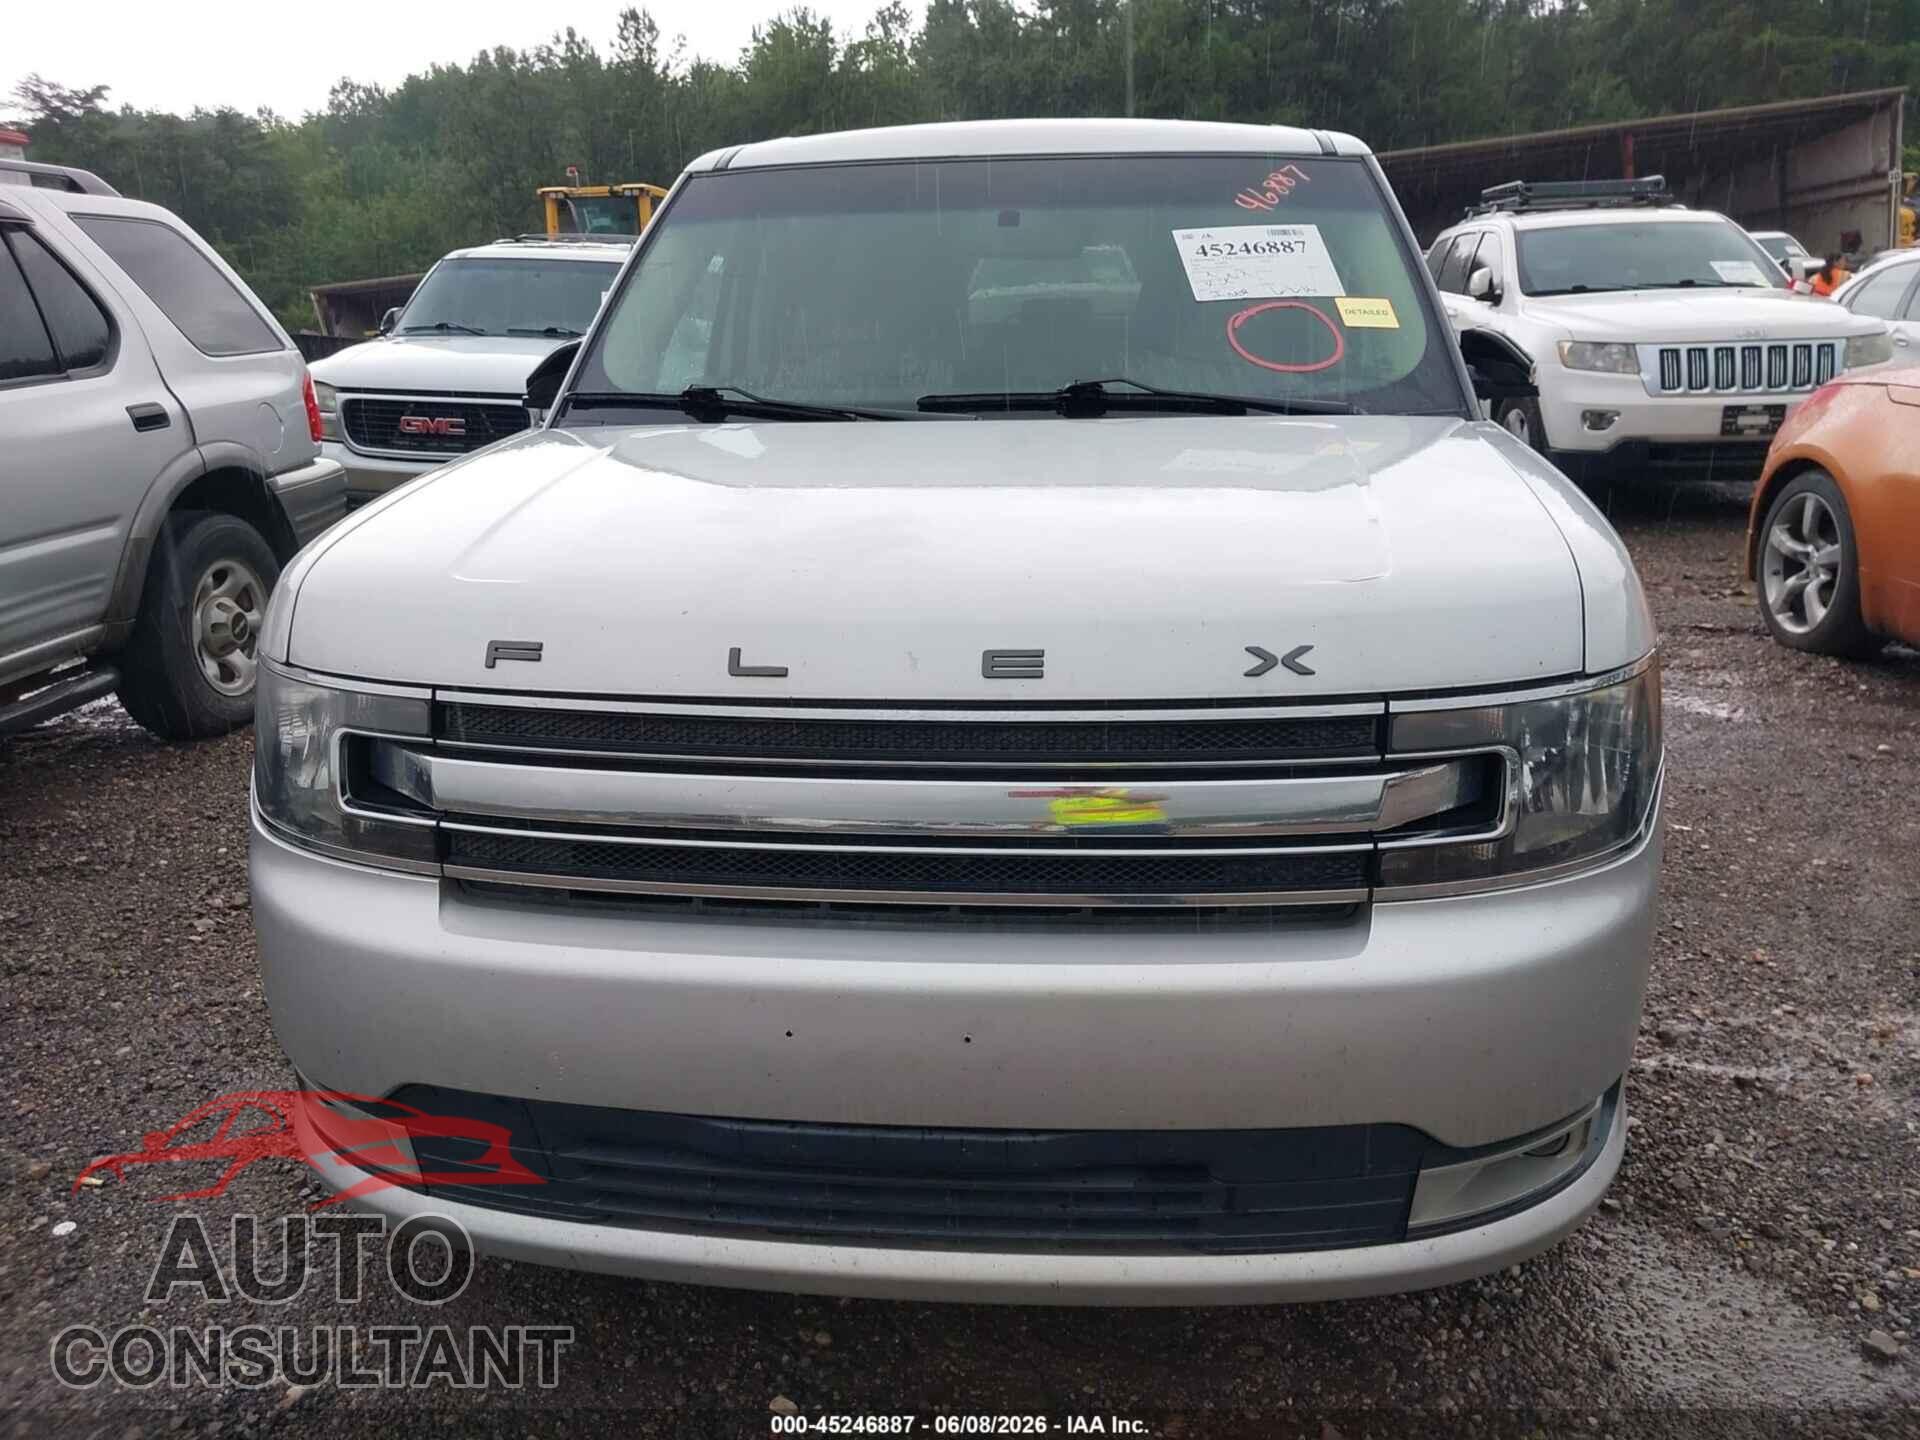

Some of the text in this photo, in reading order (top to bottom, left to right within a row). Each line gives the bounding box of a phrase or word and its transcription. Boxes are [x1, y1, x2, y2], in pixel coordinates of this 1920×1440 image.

[1195, 241, 1306, 257] 45246887
[1344, 308, 1389, 316] DETAILED
[400, 416, 465, 435] GMC
